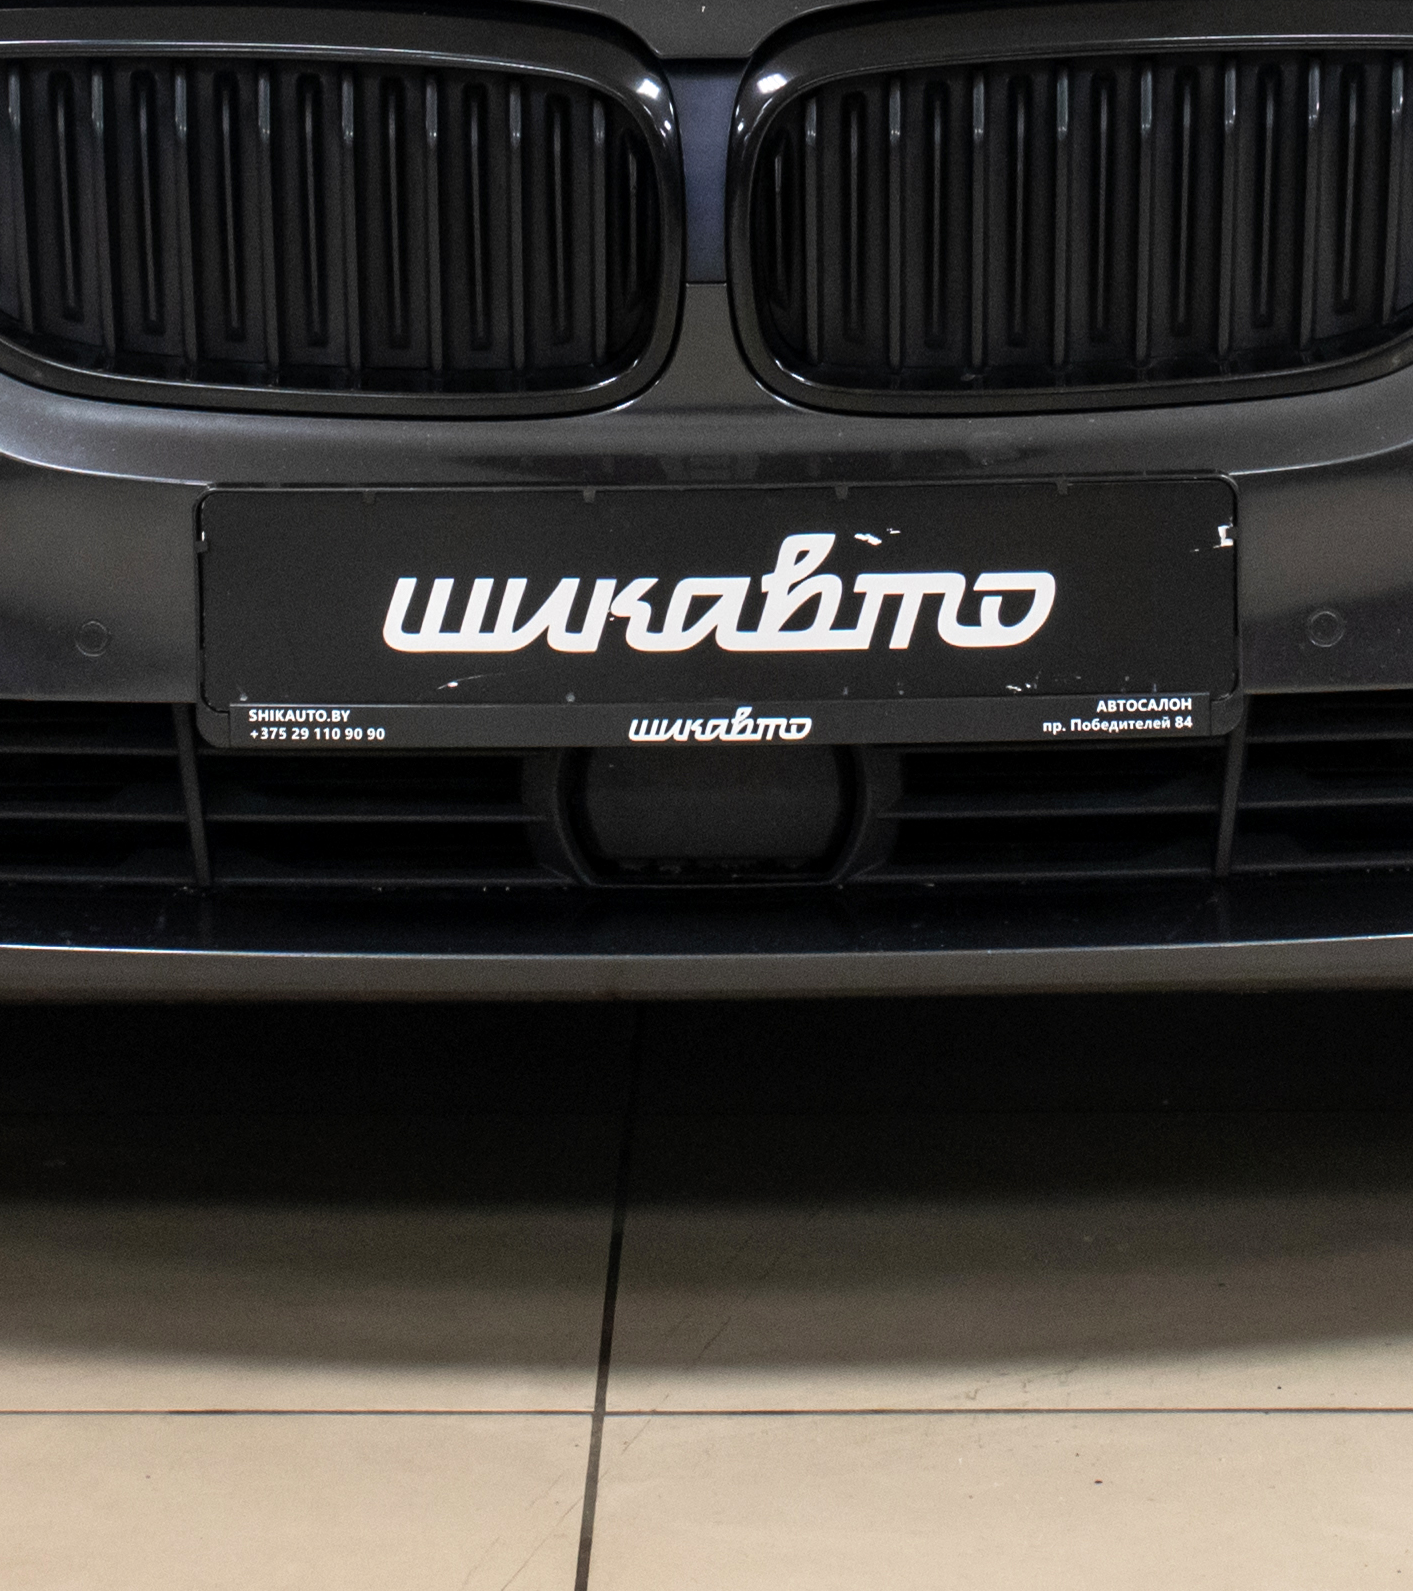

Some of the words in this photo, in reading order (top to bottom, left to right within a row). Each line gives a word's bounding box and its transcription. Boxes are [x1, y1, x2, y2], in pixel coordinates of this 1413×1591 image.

[1096, 697, 1193, 714] АВТОСАЛОН
[248, 709, 351, 723] SHIKAUTO.BY
[249, 726, 287, 741] +375
[291, 727, 310, 741] 29
[313, 727, 341, 741] 110
[344, 727, 364, 741] 90
[366, 727, 386, 741] 90
[1042, 721, 1067, 736] пр.
[1070, 715, 1171, 734] Победителей
[1174, 715, 1194, 729] 84
